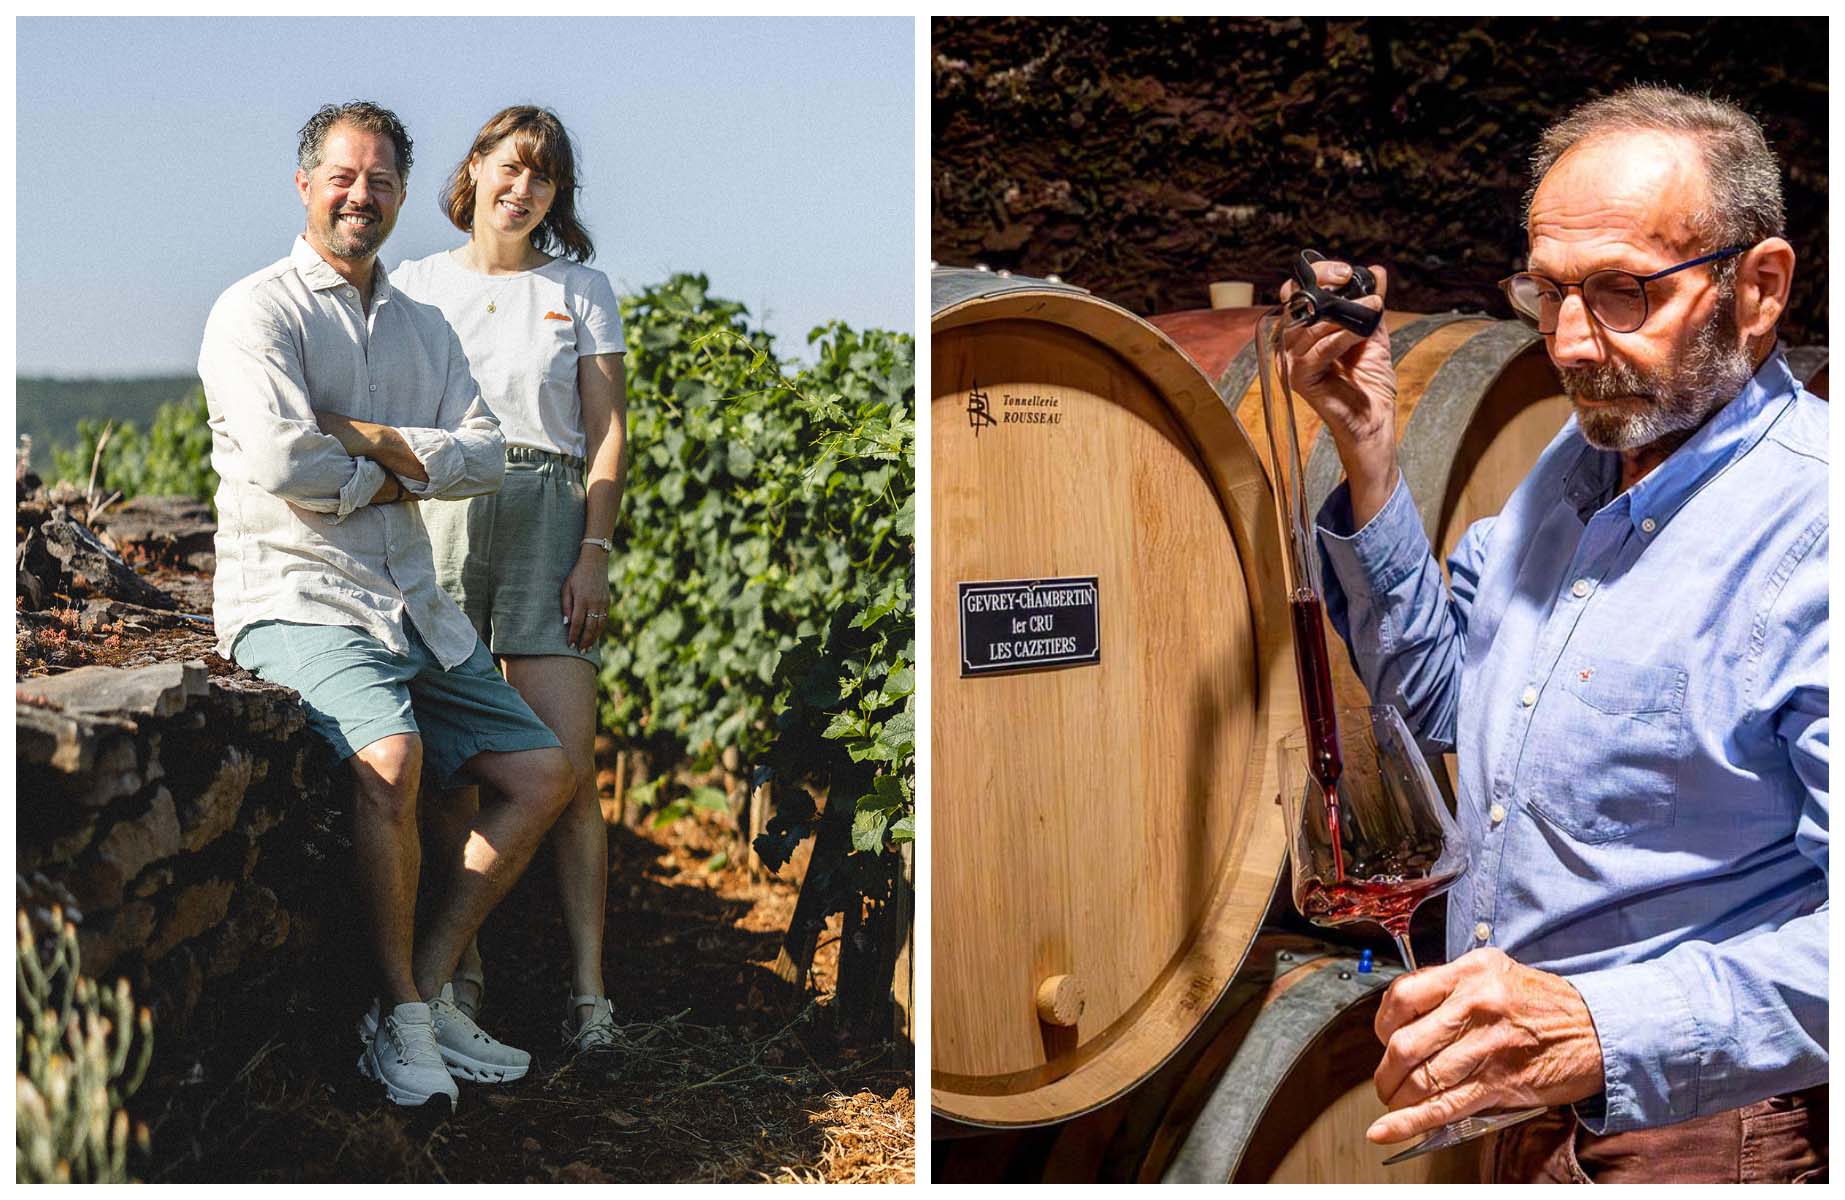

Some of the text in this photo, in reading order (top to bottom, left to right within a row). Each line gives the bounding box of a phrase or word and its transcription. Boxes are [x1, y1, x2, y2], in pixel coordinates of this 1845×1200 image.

[1003, 394, 1059, 407] Tonnellerie
[1003, 411, 1062, 424] ROUSSEAU
[967, 588, 1093, 613] GEVREY-CHAMBERTIN
[1012, 614, 1054, 634] 1er CRU
[989, 636, 1077, 661] LES CAZETIERS
